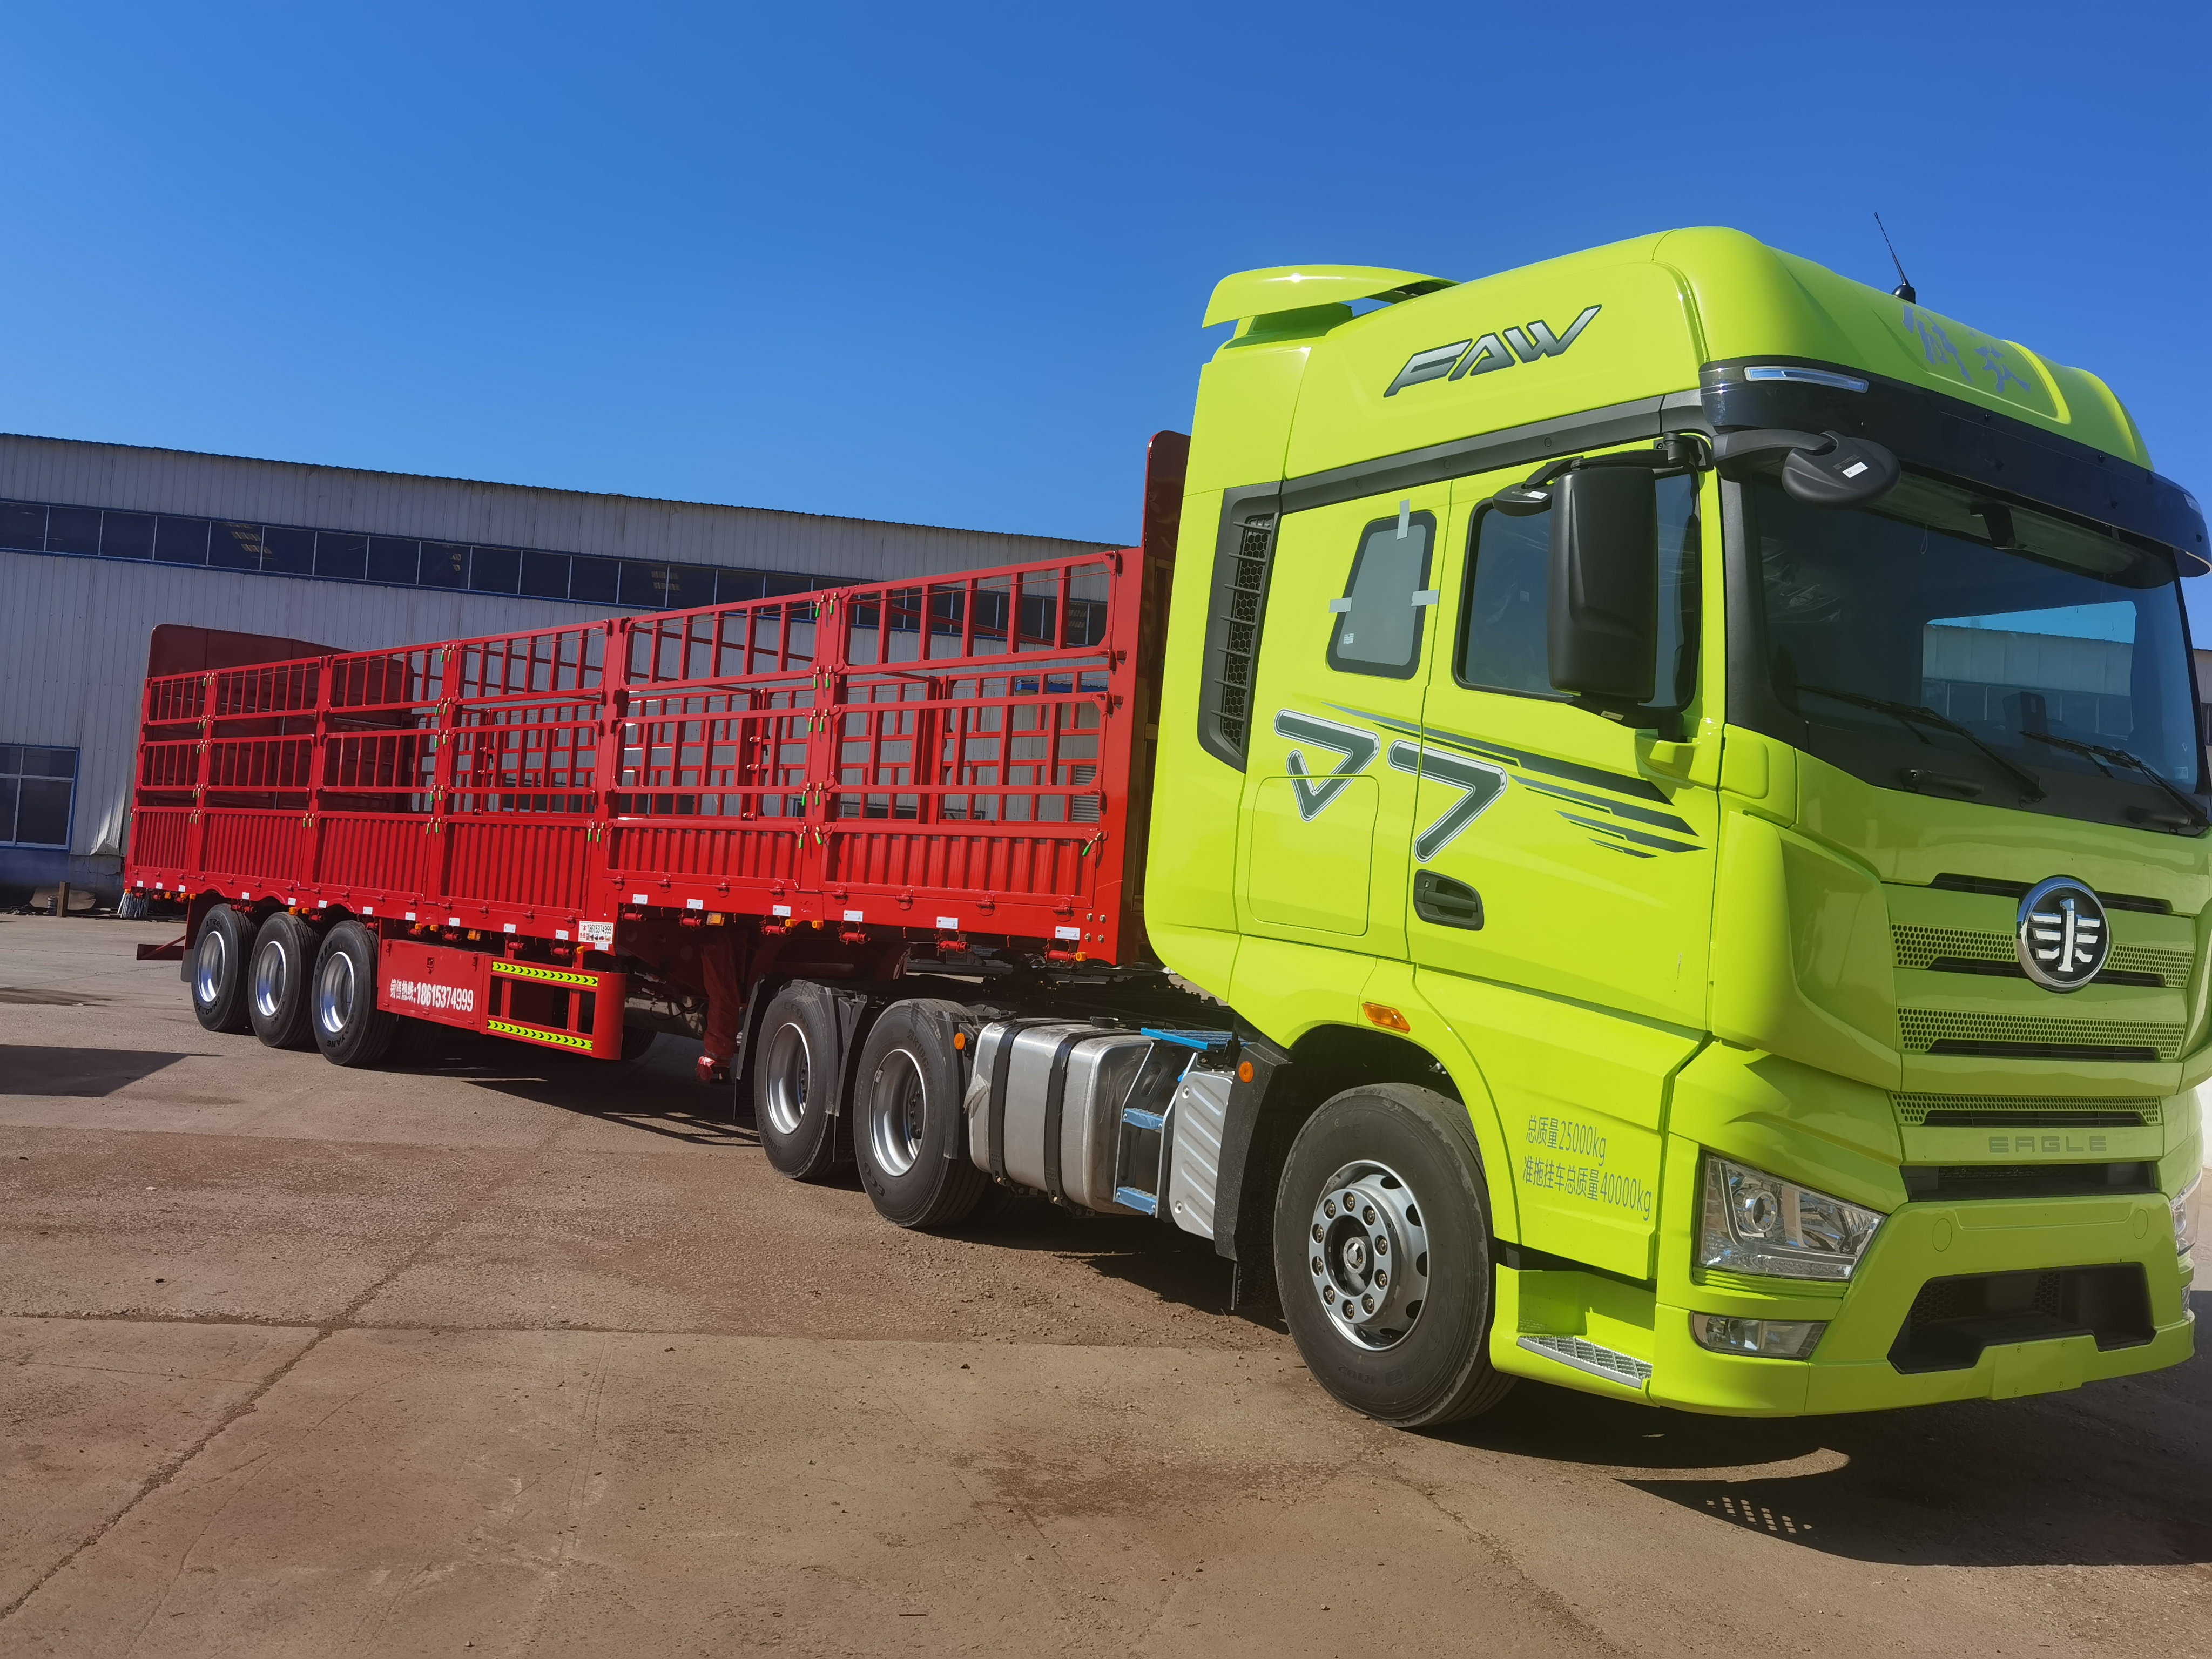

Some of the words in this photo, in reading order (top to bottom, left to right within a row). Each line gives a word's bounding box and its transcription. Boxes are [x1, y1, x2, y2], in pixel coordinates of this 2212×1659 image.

[1384, 304, 1602, 398] FAW
[587, 924, 612, 934] 18615374999
[1526, 1114, 1606, 1167] 总质量25000kg
[1988, 1136, 2107, 1153] EAGLE
[1522, 1155, 1651, 1221] 准拖挂车总质量40000kg
